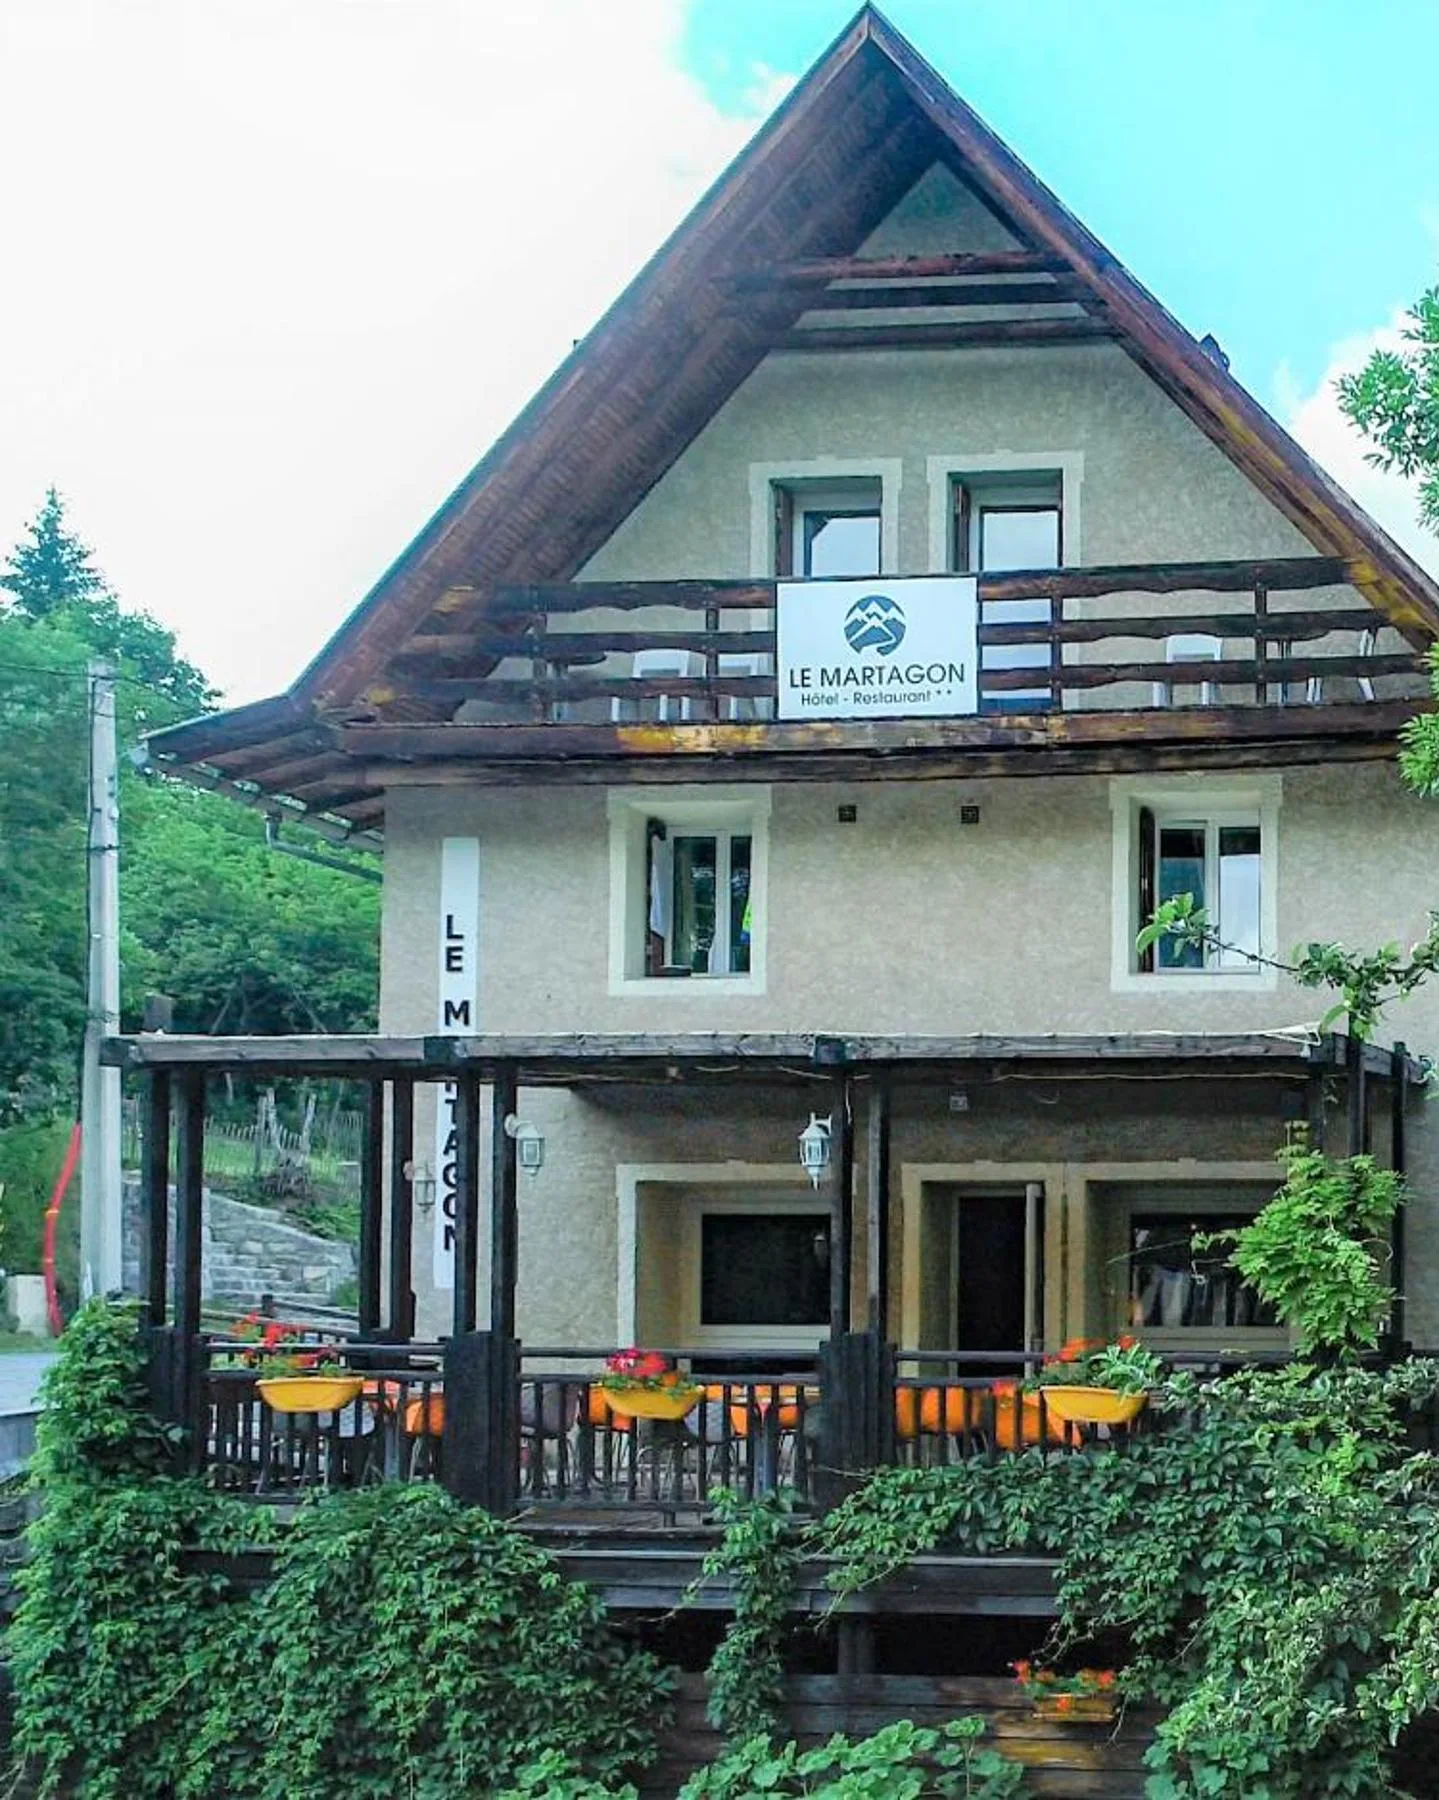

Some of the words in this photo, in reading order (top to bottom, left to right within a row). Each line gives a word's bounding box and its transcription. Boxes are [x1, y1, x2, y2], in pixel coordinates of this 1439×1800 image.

[789, 667, 812, 689] LE
[820, 662, 965, 688] MARTAGON
[801, 691, 839, 707] Hôtel
[853, 689, 931, 706] Restaurant
[446, 914, 464, 972] LE
[443, 999, 470, 1251] MTAGON
